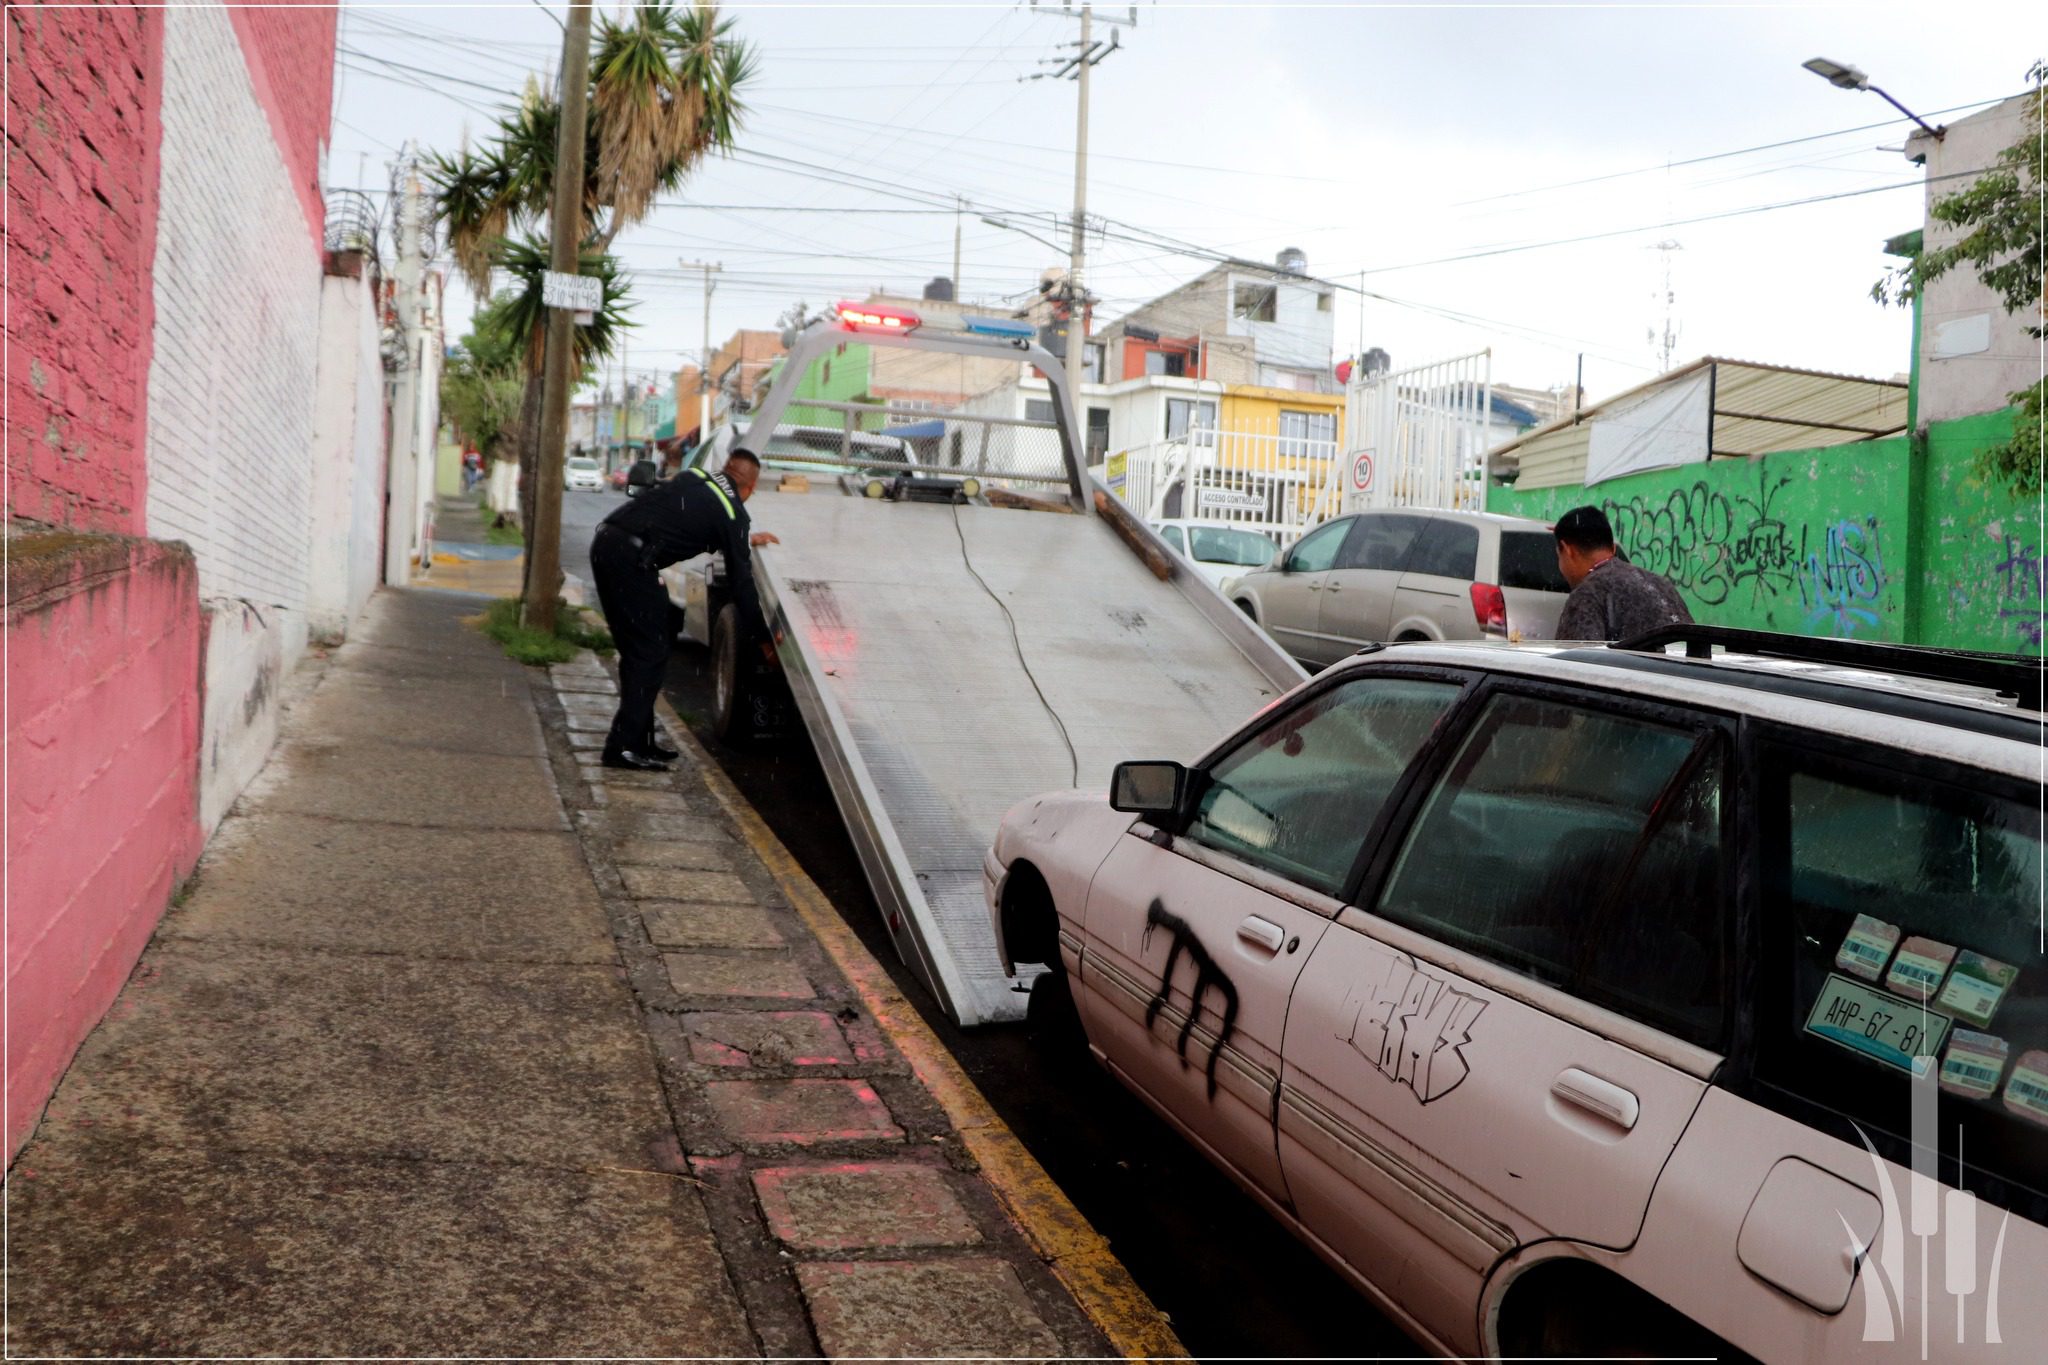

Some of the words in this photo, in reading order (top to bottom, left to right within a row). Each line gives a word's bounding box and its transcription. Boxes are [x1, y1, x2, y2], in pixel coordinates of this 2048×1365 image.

[1358, 461, 1368, 476] 10
[1204, 493, 1226, 503] ACCESO
[1227, 495, 1264, 506] CONTROLADO
